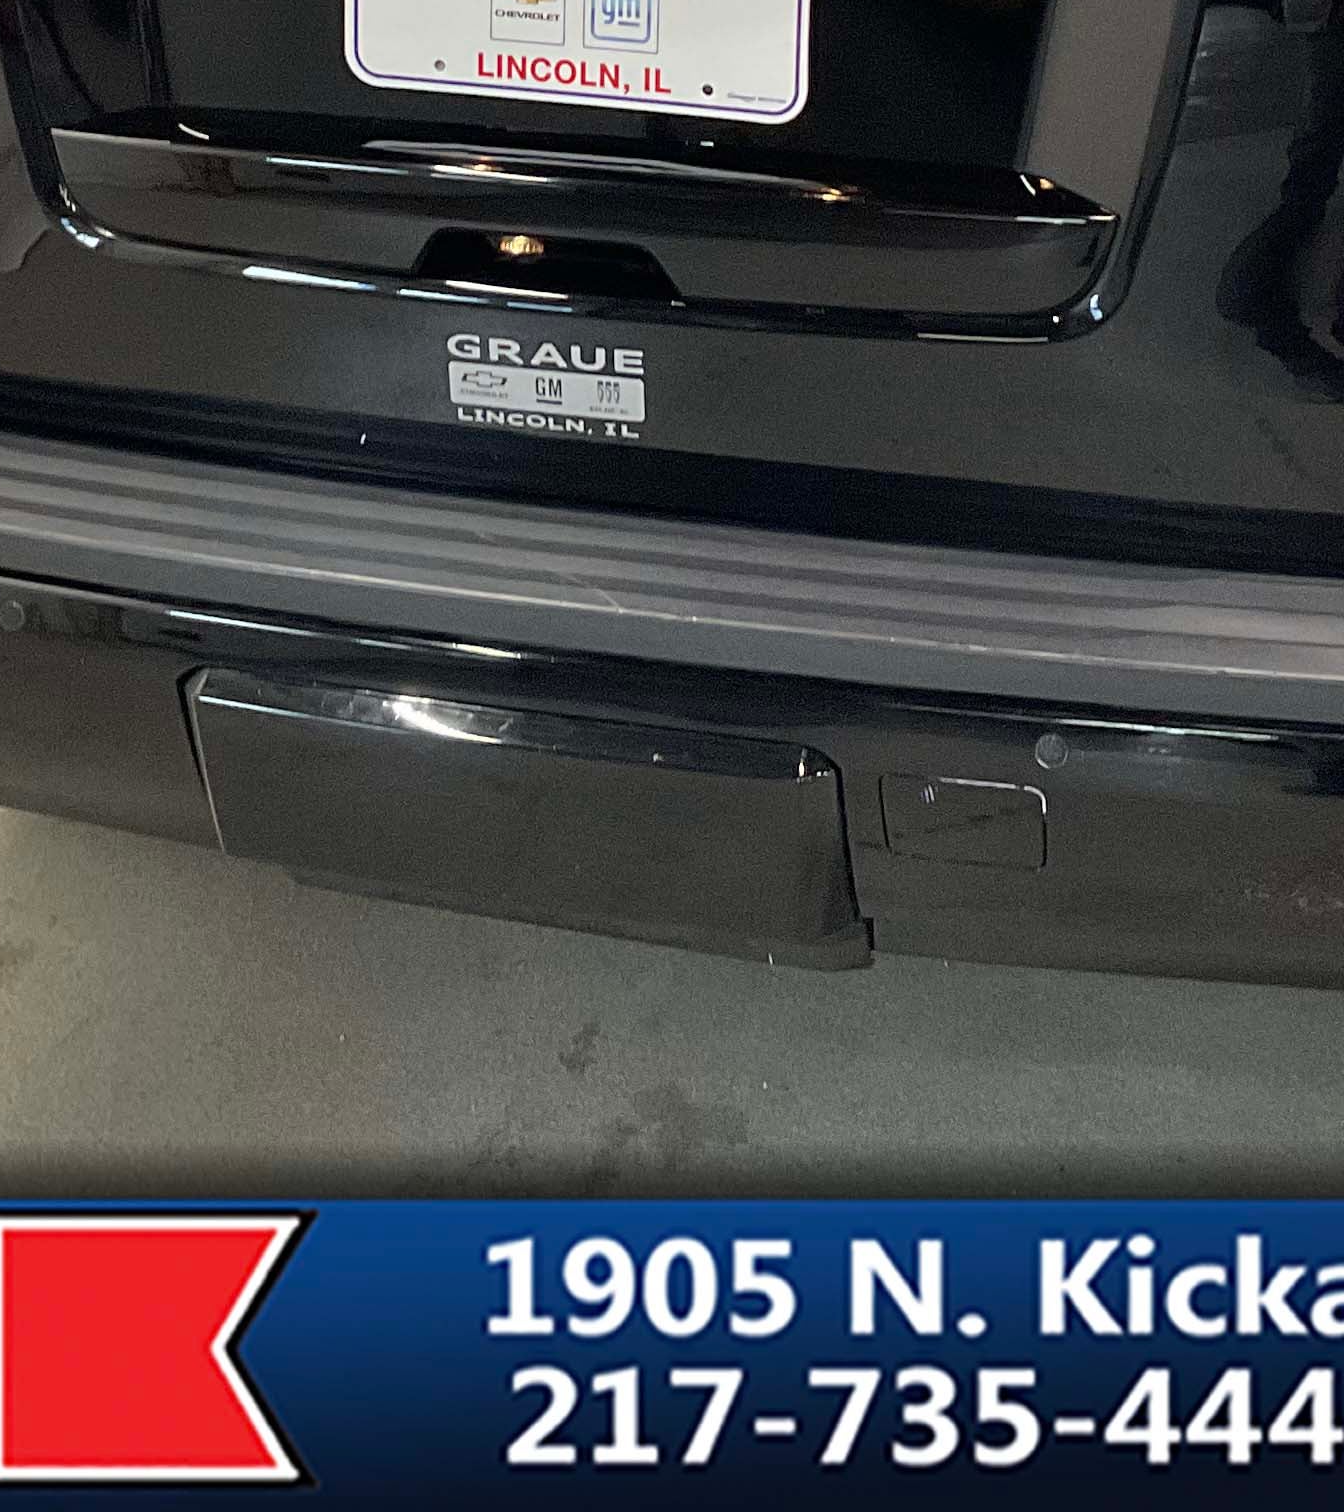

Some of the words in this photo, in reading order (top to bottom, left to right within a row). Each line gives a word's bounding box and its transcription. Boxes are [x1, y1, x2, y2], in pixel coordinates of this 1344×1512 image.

[494, 7, 561, 23] CHEVROLET
[477, 52, 631, 94] LINCOLN,
[643, 67, 672, 95] IL
[447, 333, 645, 376] GRAUE
[535, 376, 563, 400] GM
[457, 406, 593, 435] LINCOLN,
[604, 421, 640, 438] IL
